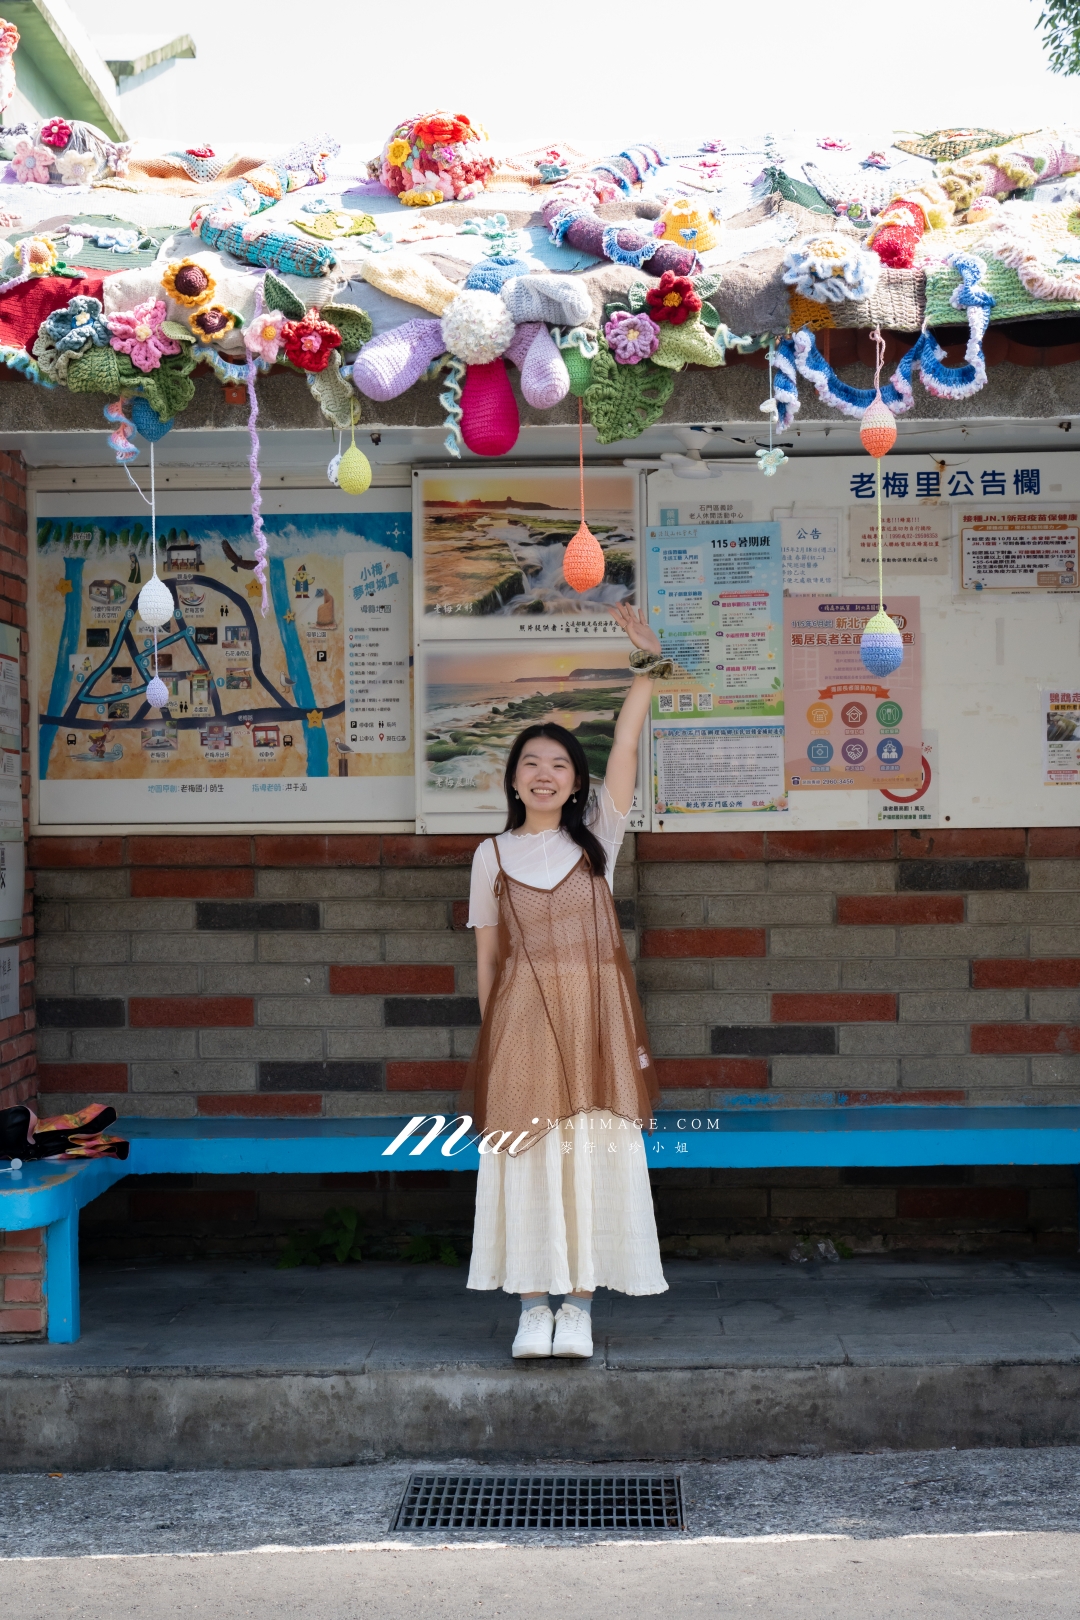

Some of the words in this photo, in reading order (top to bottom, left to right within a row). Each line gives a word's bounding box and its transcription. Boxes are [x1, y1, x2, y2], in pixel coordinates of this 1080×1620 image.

[850, 469, 1041, 498] 老梅里公告欄
[689, 512, 744, 520] 老人休閒活動中心
[963, 514, 1078, 522] 接種JN.1新冠疫苗保健康
[796, 528, 822, 540] 公告
[711, 540, 728, 548] 115
[738, 536, 771, 548] 暑期班
[360, 562, 383, 581] 小梅
[352, 572, 399, 600] 夢想城真
[360, 605, 392, 614] 導覽地圖
[791, 633, 914, 645] 獨居長者全面查
[686, 801, 743, 809] 新北市石門區公所
